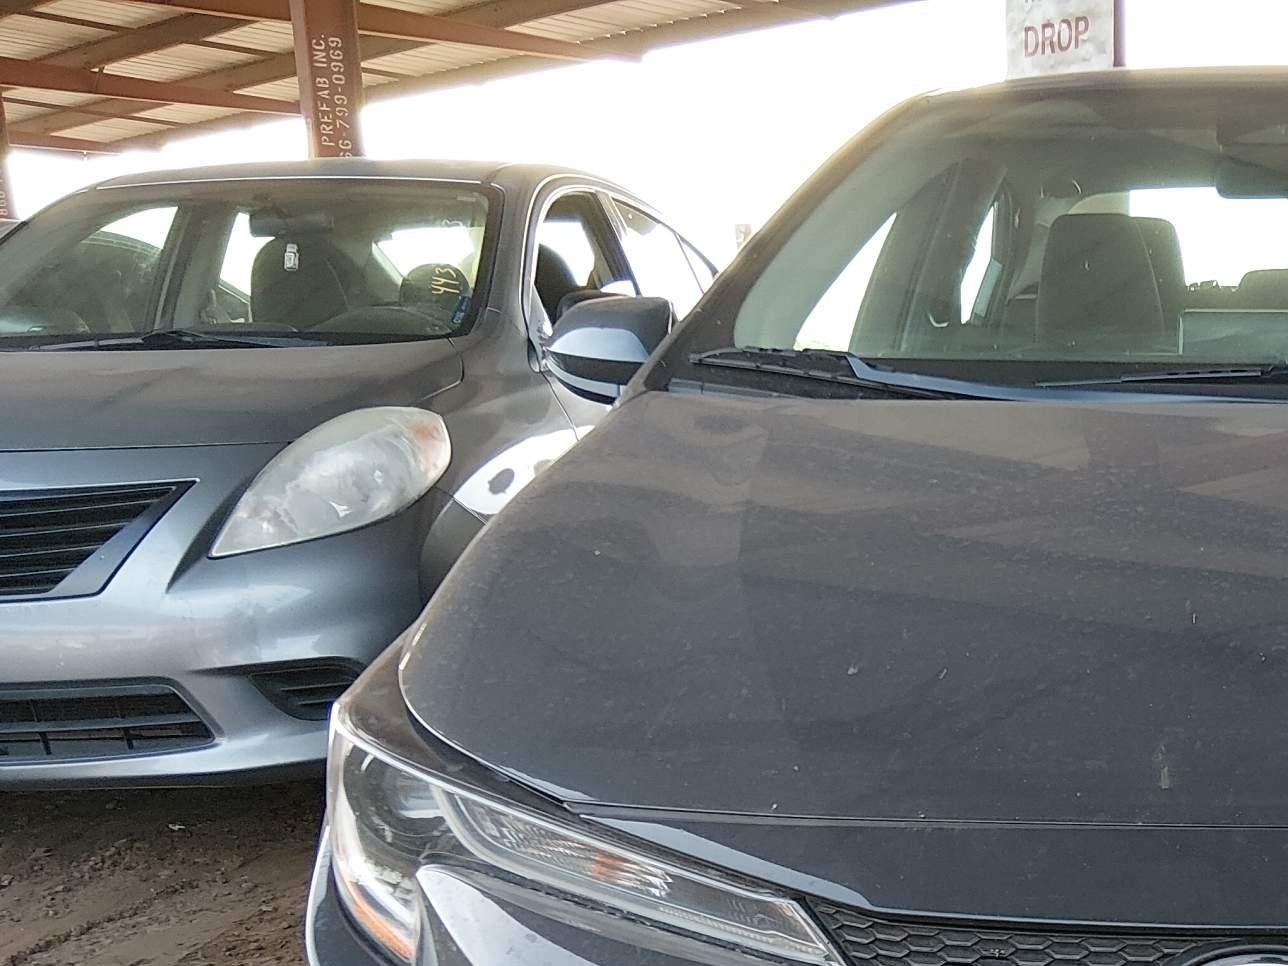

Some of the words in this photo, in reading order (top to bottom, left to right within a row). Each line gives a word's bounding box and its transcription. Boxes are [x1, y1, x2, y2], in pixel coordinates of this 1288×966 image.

[312, 34, 328, 68] INC.
[1024, 16, 1089, 57] DROP
[315, 77, 336, 146] PREFAB
